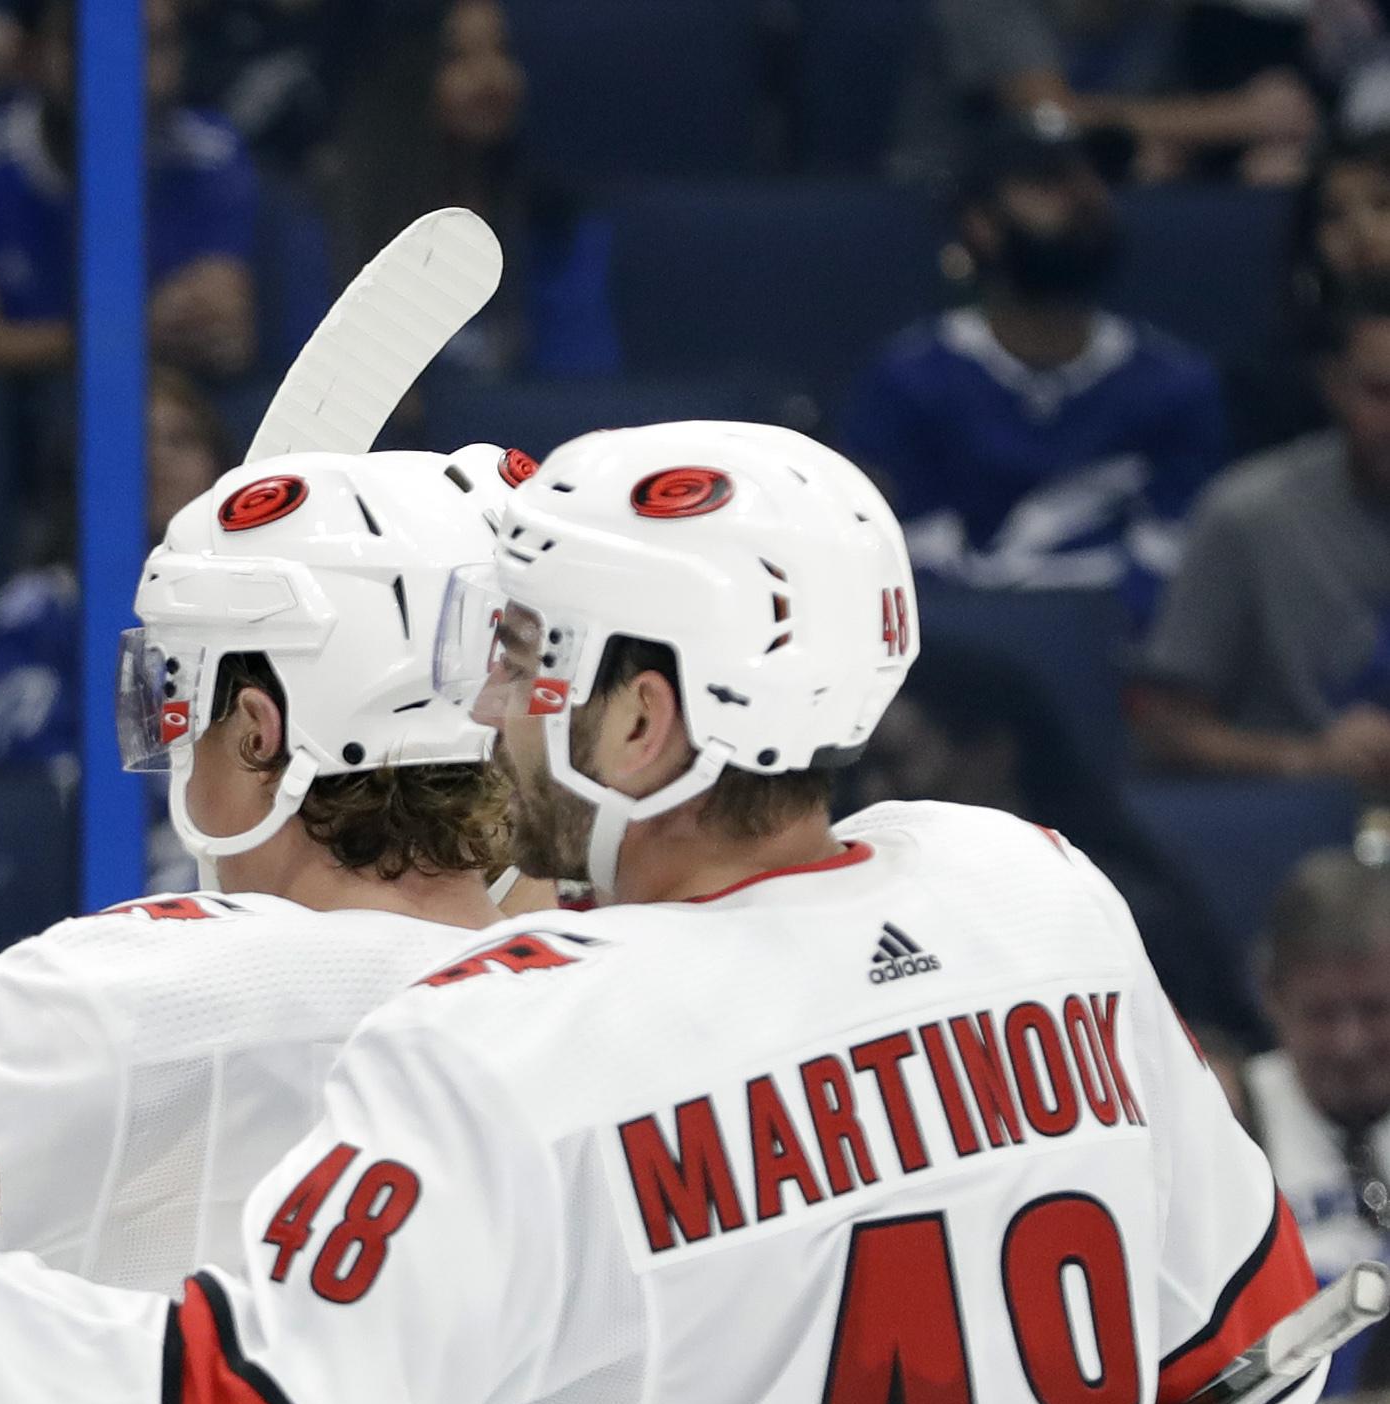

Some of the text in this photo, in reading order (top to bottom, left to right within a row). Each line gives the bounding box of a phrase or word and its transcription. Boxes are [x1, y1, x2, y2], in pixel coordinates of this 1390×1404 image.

[881, 586, 909, 657] 48
[868, 953, 942, 984] adidas
[618, 990, 1149, 1254] MARTINOOK
[262, 1141, 423, 1305] 48
